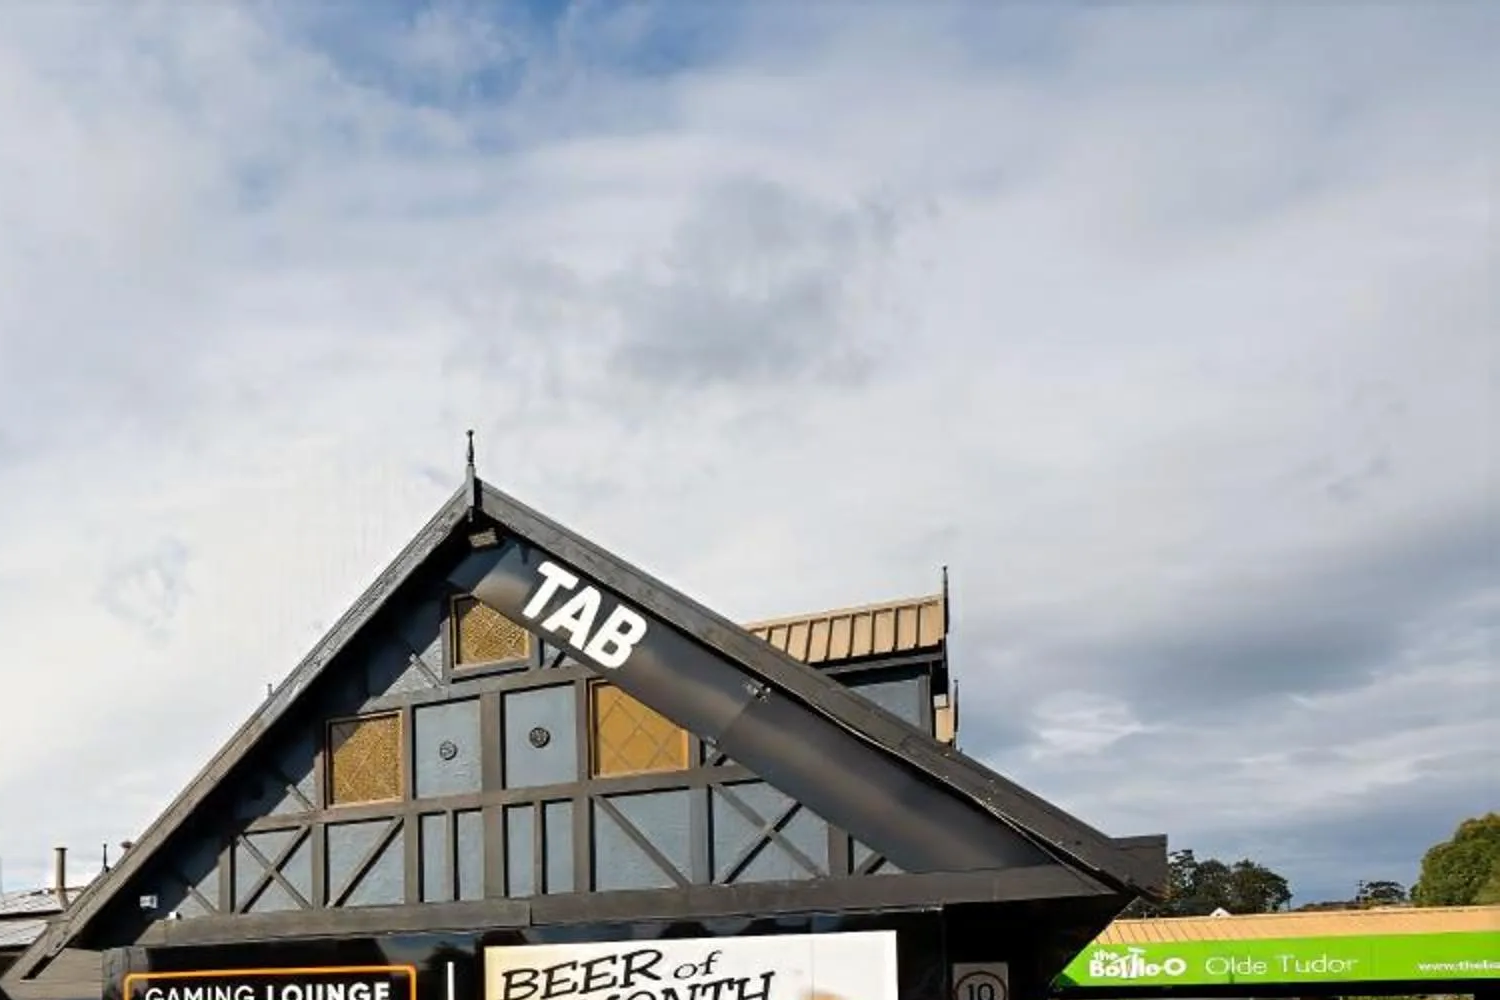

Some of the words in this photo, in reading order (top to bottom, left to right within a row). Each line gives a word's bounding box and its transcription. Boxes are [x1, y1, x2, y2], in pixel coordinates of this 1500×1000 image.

[522, 561, 647, 669] TAB
[674, 951, 721, 980] of
[1205, 956, 1268, 976] Olde
[1275, 954, 1359, 973] Tudor
